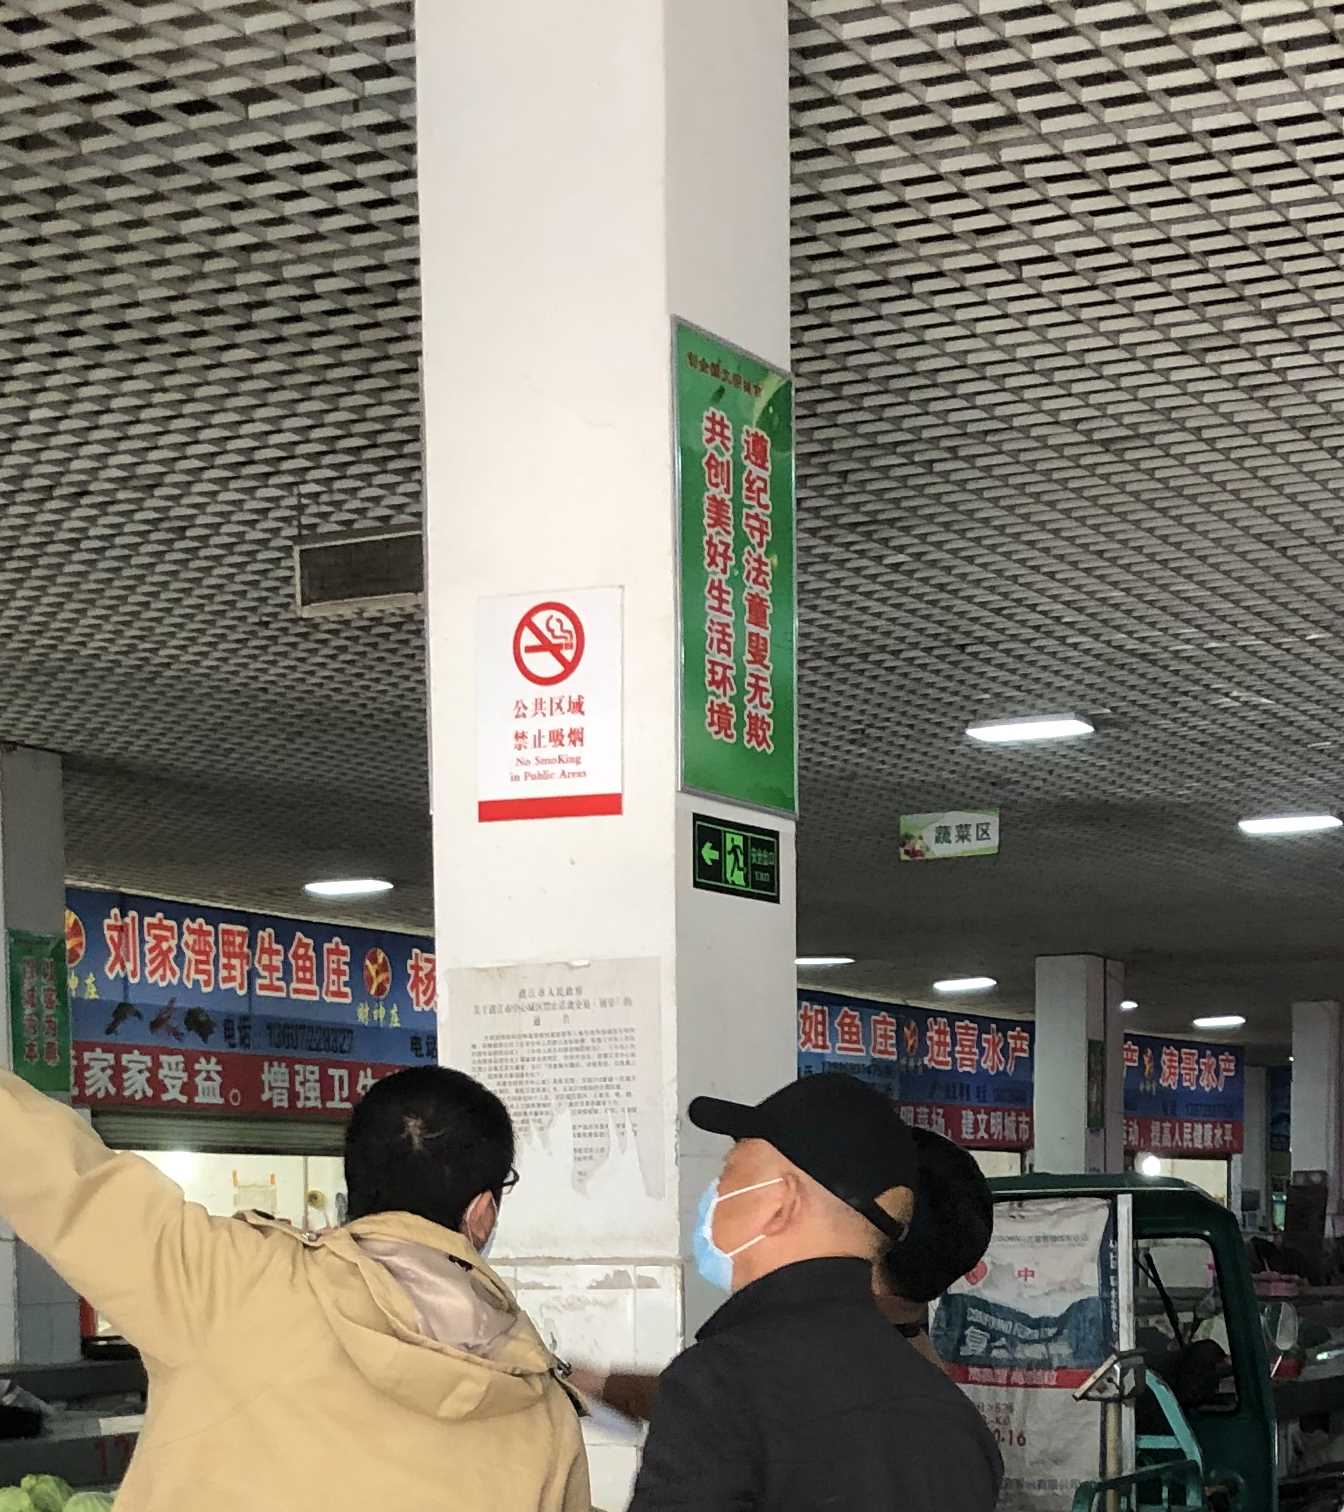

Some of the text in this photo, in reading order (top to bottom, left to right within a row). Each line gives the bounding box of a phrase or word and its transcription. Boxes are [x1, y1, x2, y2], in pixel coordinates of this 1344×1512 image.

[702, 407, 736, 742] 共创美好生活环境
[741, 425, 774, 755] 遵纪守法童叟无欺
[512, 695, 585, 719] 公共区域
[513, 727, 585, 751] 禁止吸烟
[510, 769, 587, 782] in Public Areas
[515, 756, 531, 767] No
[934, 822, 992, 845] 蔬菜区
[104, 907, 353, 1003] 刘家湾野生鱼庄
[798, 1001, 898, 1059] 姐鱼庄
[926, 1016, 1031, 1076] 进喜水产
[1159, 1046, 1236, 1092] 涛哥水产
[1017, 1267, 1035, 1282] 中
